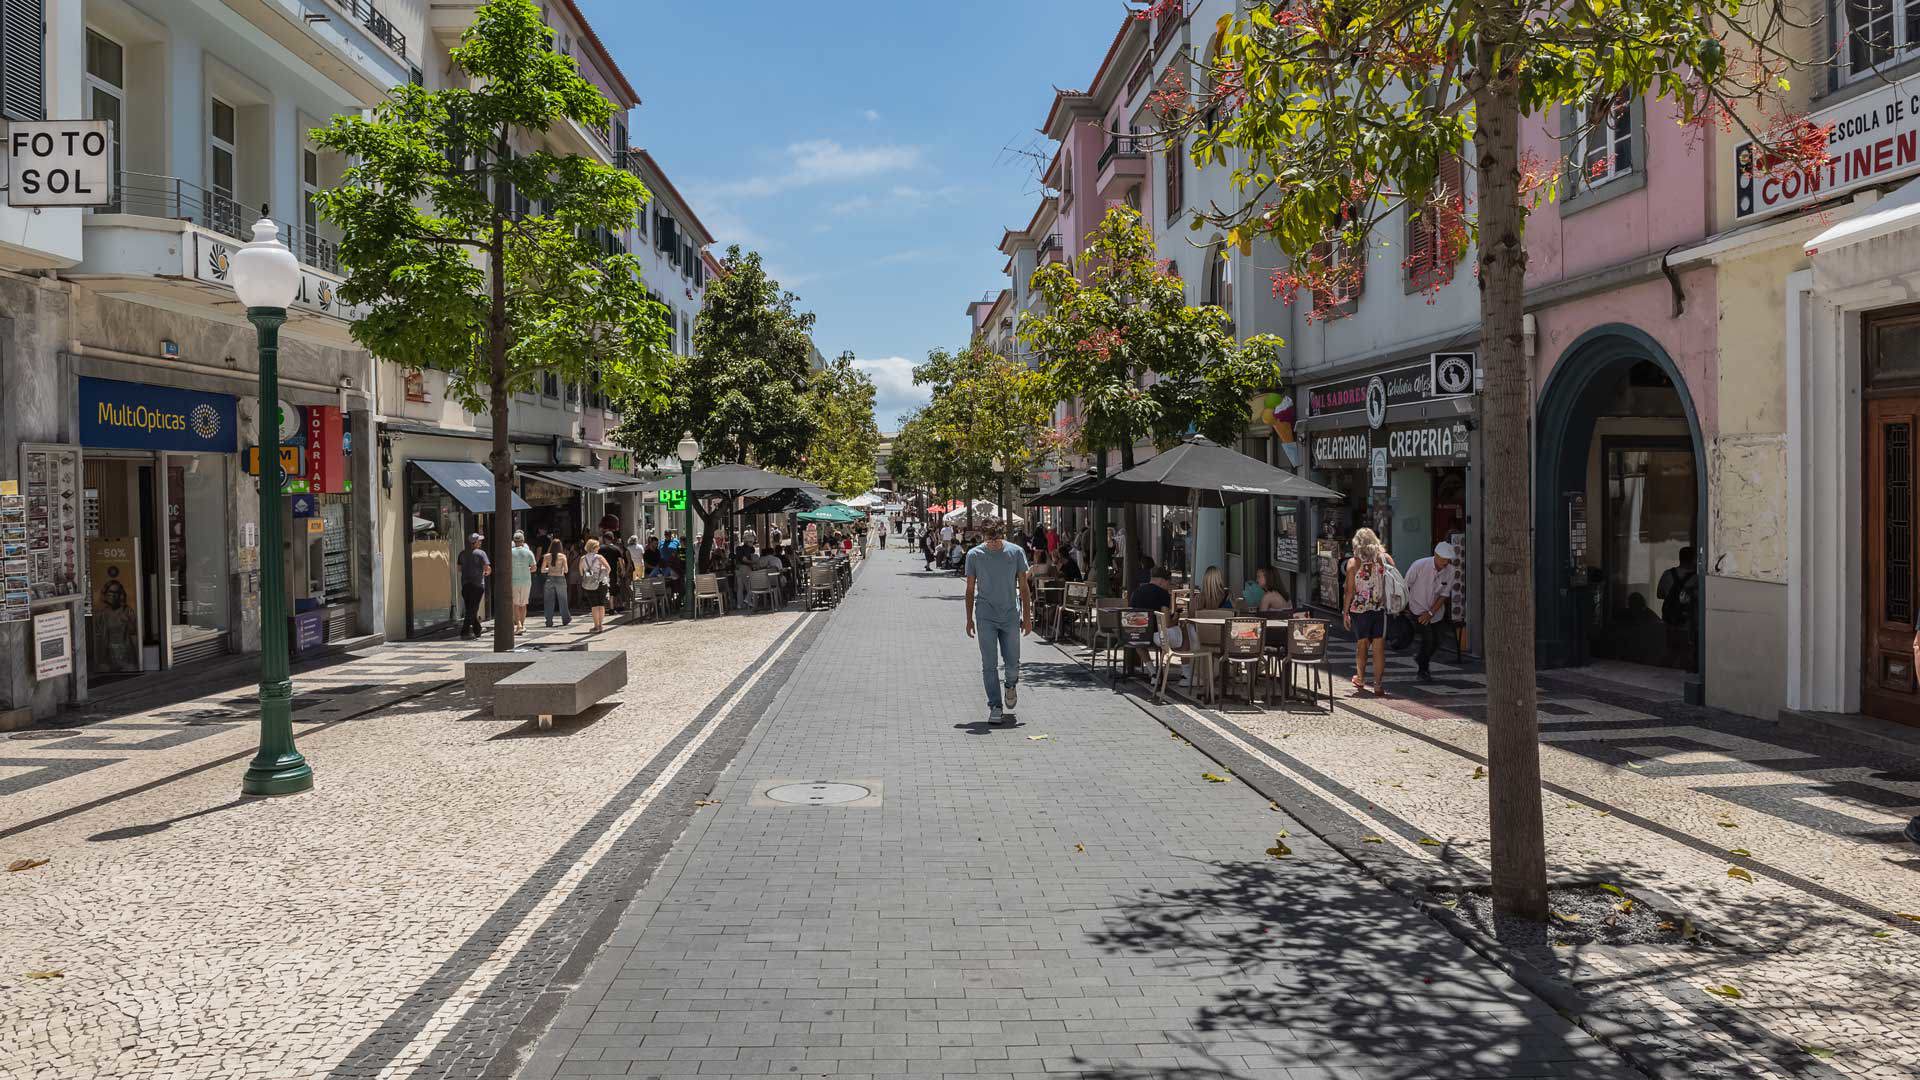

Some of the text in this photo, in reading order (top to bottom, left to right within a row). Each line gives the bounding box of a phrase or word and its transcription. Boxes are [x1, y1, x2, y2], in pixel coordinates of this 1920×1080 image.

[1829, 110, 1880, 144] ESCOLA
[1885, 101, 1904, 125] DE
[13, 131, 105, 157] FOTO
[22, 168, 91, 194] SOL
[98, 402, 186, 433] MultiOpticas
[312, 409, 321, 491] LOTARIAS
[1316, 427, 1452, 460] GELATARIA CREPERIA
